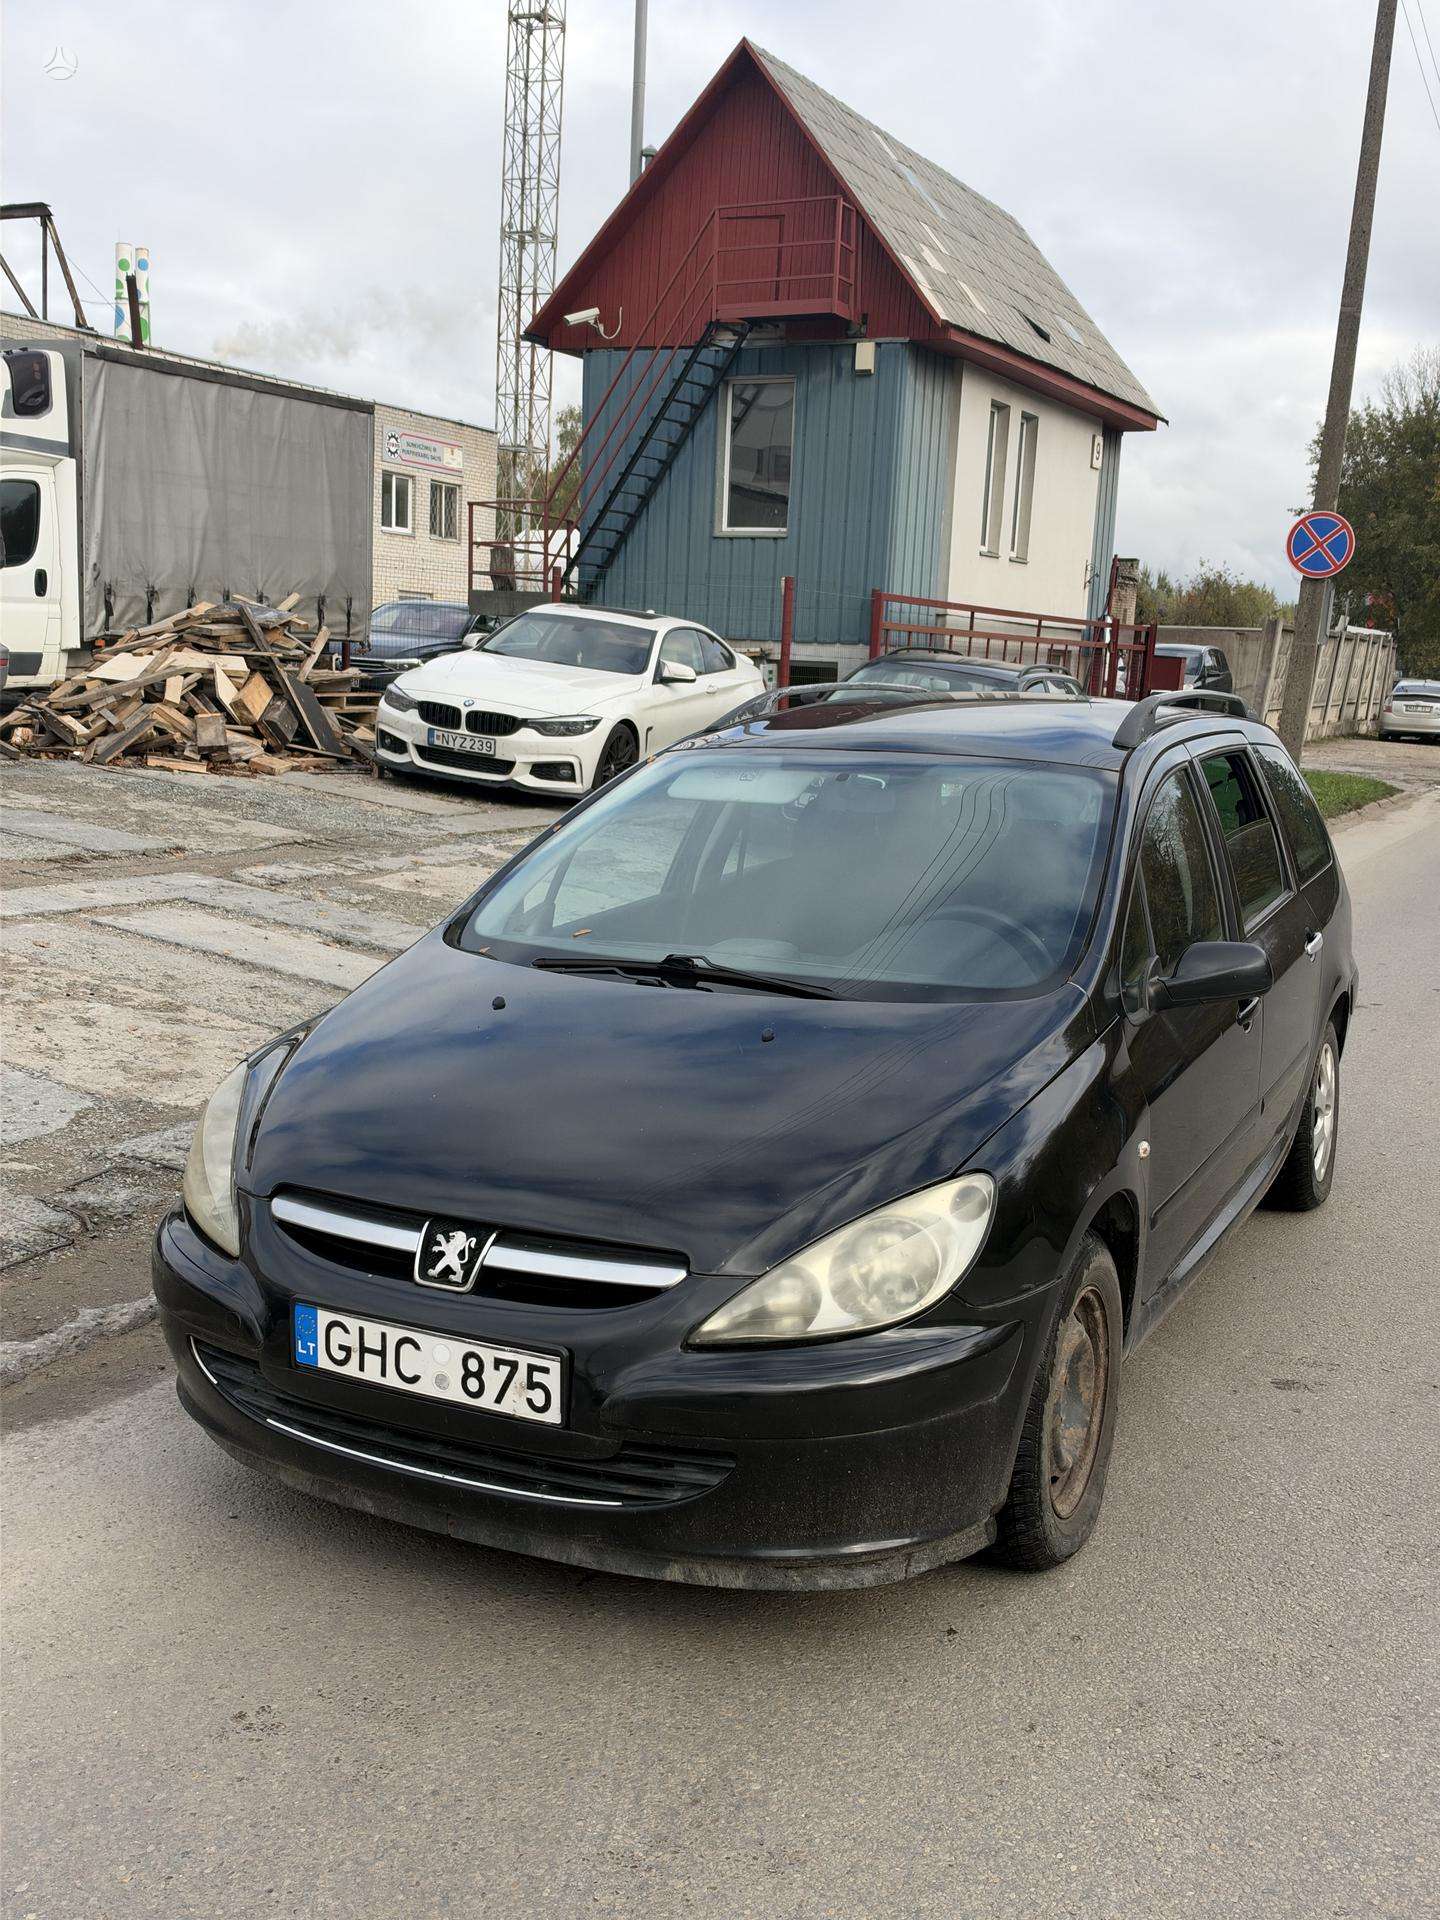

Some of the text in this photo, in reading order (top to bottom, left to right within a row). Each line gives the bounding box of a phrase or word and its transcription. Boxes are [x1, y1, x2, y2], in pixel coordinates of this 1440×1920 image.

[1096, 442, 1101, 460] 9
[441, 733, 493, 753] NYZ239
[297, 1339, 316, 1356] LT
[324, 1319, 552, 1414] GHC 875
